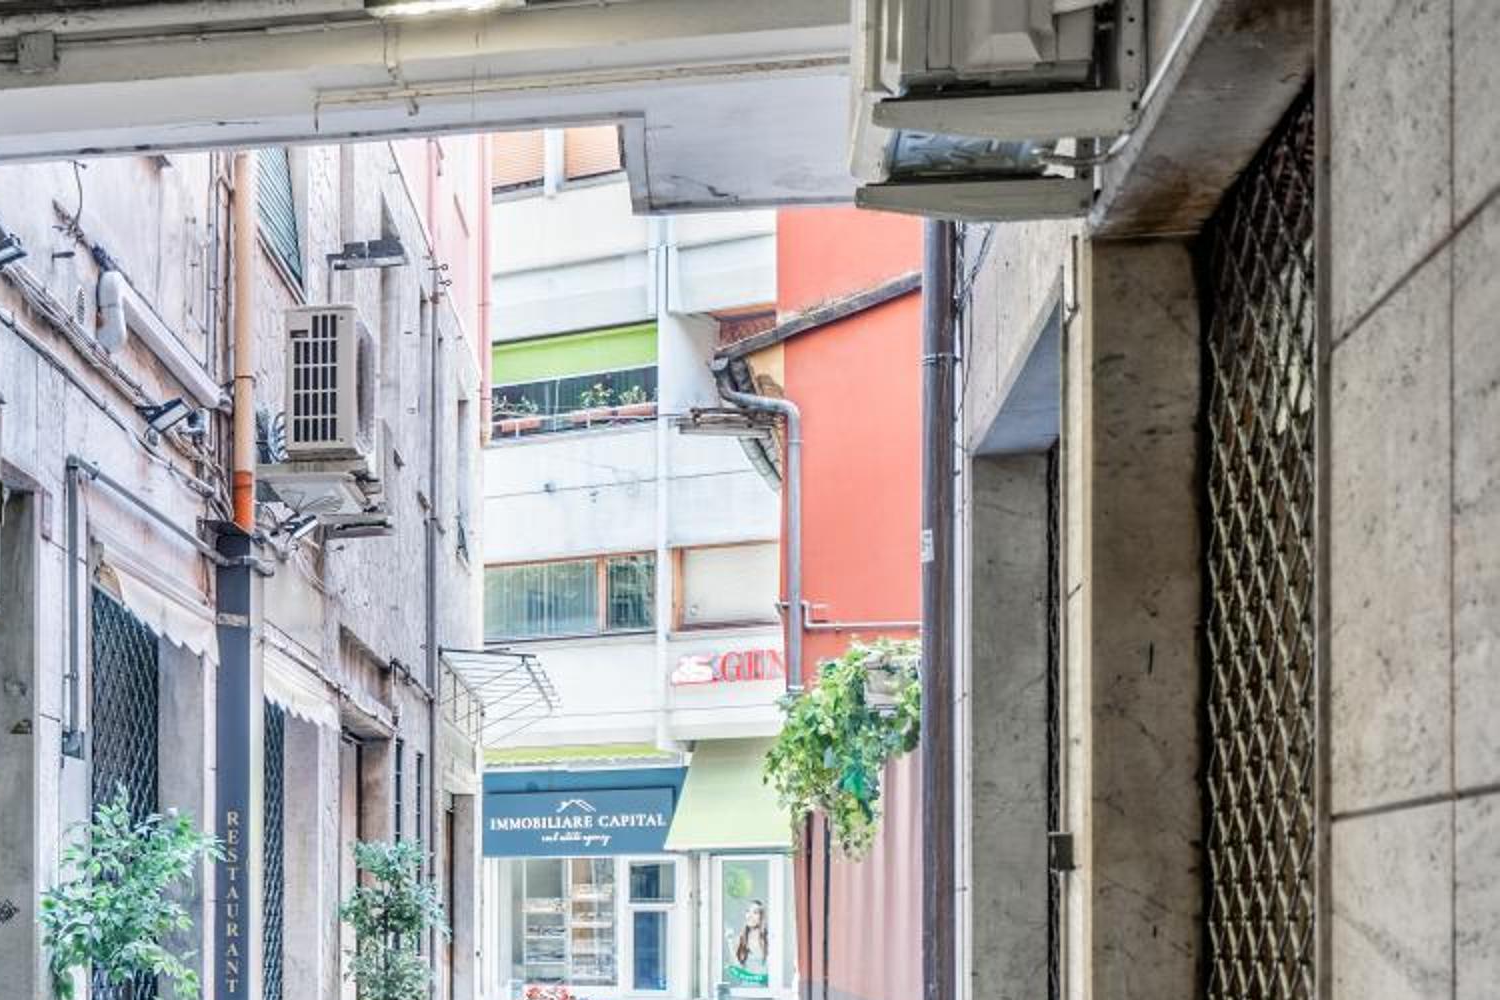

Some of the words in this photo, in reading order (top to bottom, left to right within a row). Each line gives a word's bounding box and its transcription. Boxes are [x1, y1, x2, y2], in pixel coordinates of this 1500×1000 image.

[490, 815, 593, 831] IMMOBILIARE
[598, 813, 667, 828] CAPITAL
[226, 811, 240, 993] RESTAURANT
